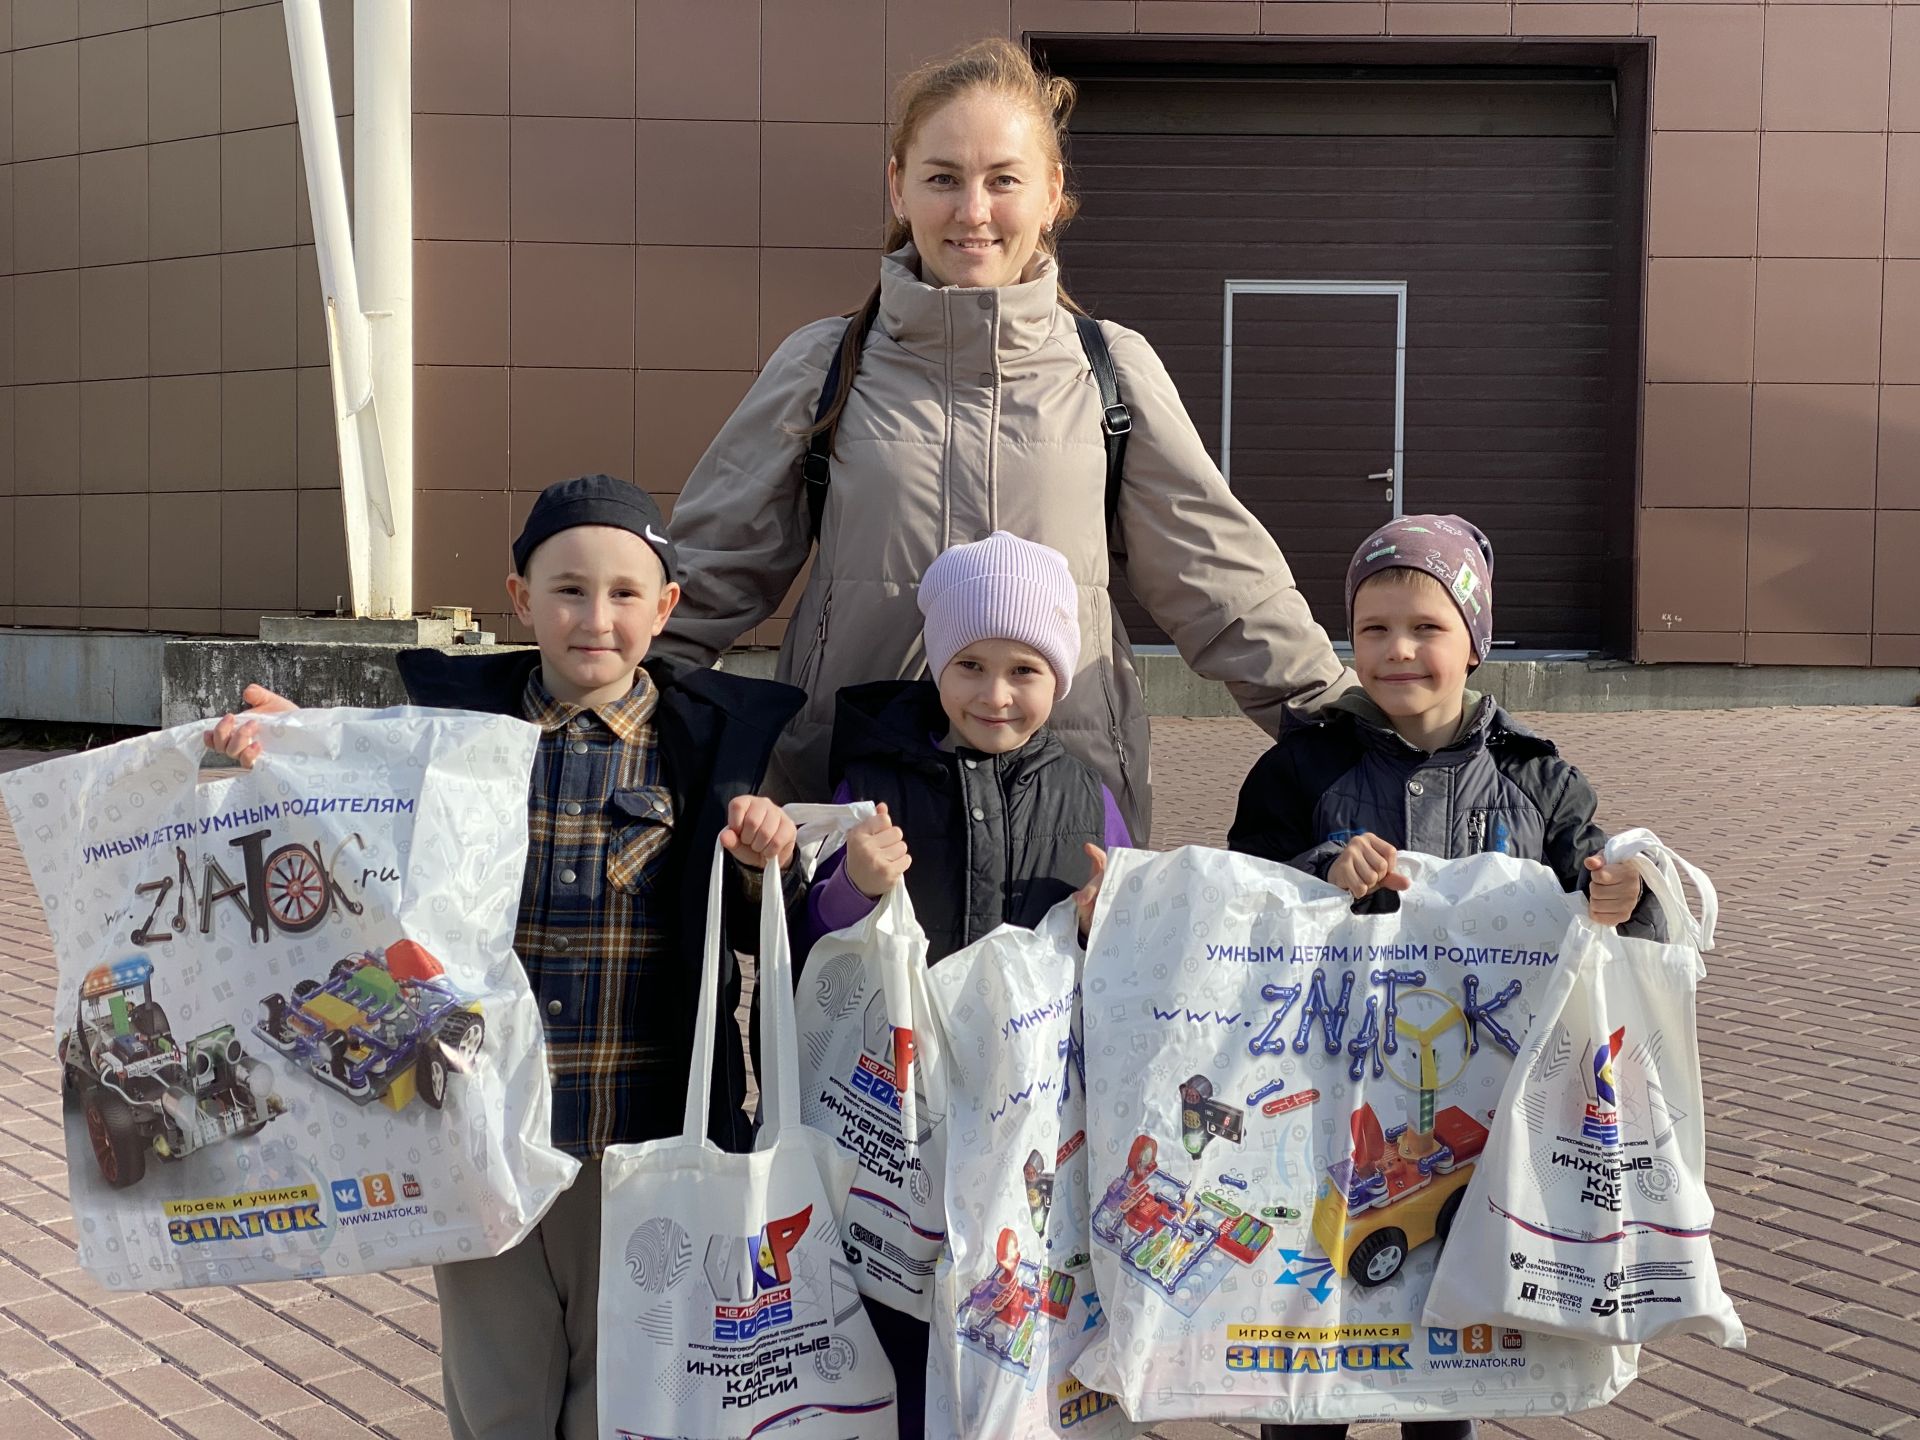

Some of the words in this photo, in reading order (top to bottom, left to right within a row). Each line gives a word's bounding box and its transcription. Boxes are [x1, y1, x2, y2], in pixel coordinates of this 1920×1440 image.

[82, 832, 150, 865] УМНЫМ
[198, 802, 280, 835] УМНЫМ
[282, 798, 415, 817] РОДИТЕЛЯМ
[1206, 943, 1284, 963] УМНЫМ
[1290, 945, 1348, 964] ДЕТЯМ
[1353, 946, 1362, 962] И
[1368, 945, 1428, 963] УМНЫМ
[1434, 947, 1560, 966] РОДИТЕЛЯМ
[402, 1172, 415, 1183] You
[403, 1185, 420, 1196] Tube
[173, 1201, 226, 1216] играем
[233, 1197, 243, 1207] и
[250, 1188, 309, 1207] учимся
[168, 1204, 327, 1245] ЗНАТОК
[339, 1205, 428, 1226] WWW.ZNATOK.RU
[1525, 1262, 1568, 1276] ОБРАЗОВАНИЯ
[1574, 1274, 1596, 1283] НАУКИ
[1538, 1258, 1585, 1274] МИНИСТЕРСТВО
[1538, 1294, 1582, 1309] ТВОРЧЕСТВО
[1539, 1287, 1583, 1303] ТЕХНИЧЕСКОЕ
[713, 1301, 792, 1342] 2025
[1239, 1327, 1311, 1340] играем
[1319, 1330, 1328, 1340] и
[1333, 1326, 1401, 1341] учимся
[1503, 1336, 1521, 1347] Tube
[687, 1336, 831, 1377] ИНЖЕНЕРНЫЕ
[1226, 1343, 1414, 1374] ЗНАТОК
[1430, 1358, 1526, 1369] WWW.ZNATOK.RU
[727, 1361, 793, 1393] КАДРЫ
[722, 1376, 798, 1409] РОССИИ
